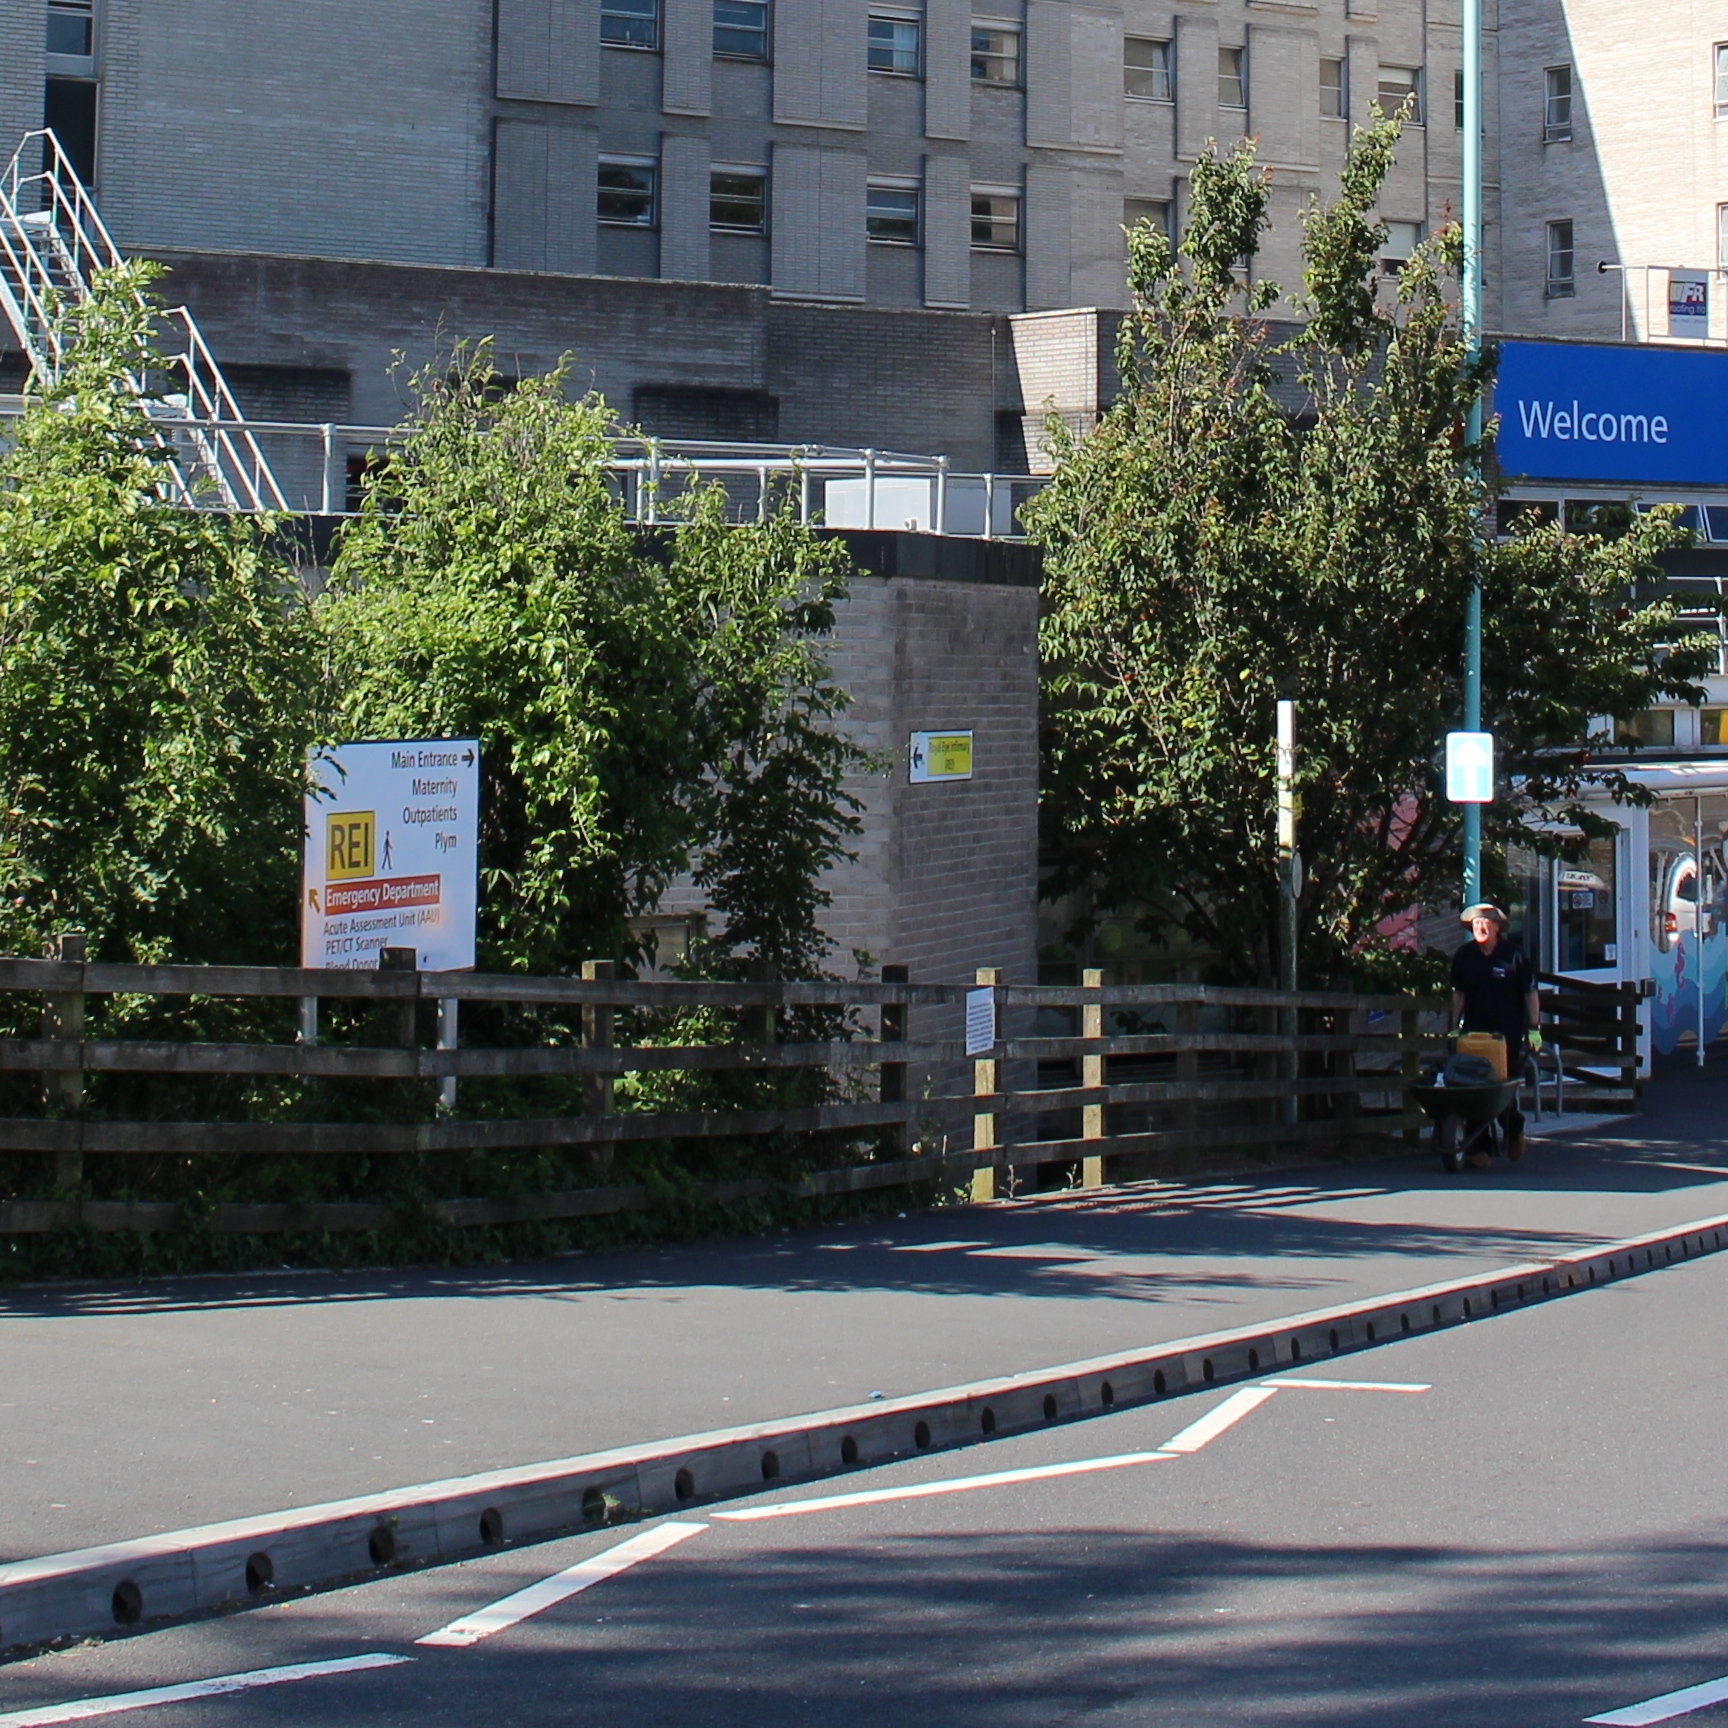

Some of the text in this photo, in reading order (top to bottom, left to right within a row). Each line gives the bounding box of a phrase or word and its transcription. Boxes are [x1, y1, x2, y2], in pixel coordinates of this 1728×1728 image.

[1518, 399, 1668, 444] Welcome
[942, 741, 951, 755] Eye
[951, 740, 969, 753] Infirmary
[392, 751, 458, 769] Main Entrance
[413, 776, 457, 799] Maternity
[403, 804, 457, 828] Outpatients
[331, 822, 368, 870] REI
[435, 832, 457, 854] Plym
[327, 880, 438, 909] Emergency Department
[323, 908, 440, 936] Acute Assessment Unit (AAU)
[326, 936, 388, 956] PET/CT Scanner
